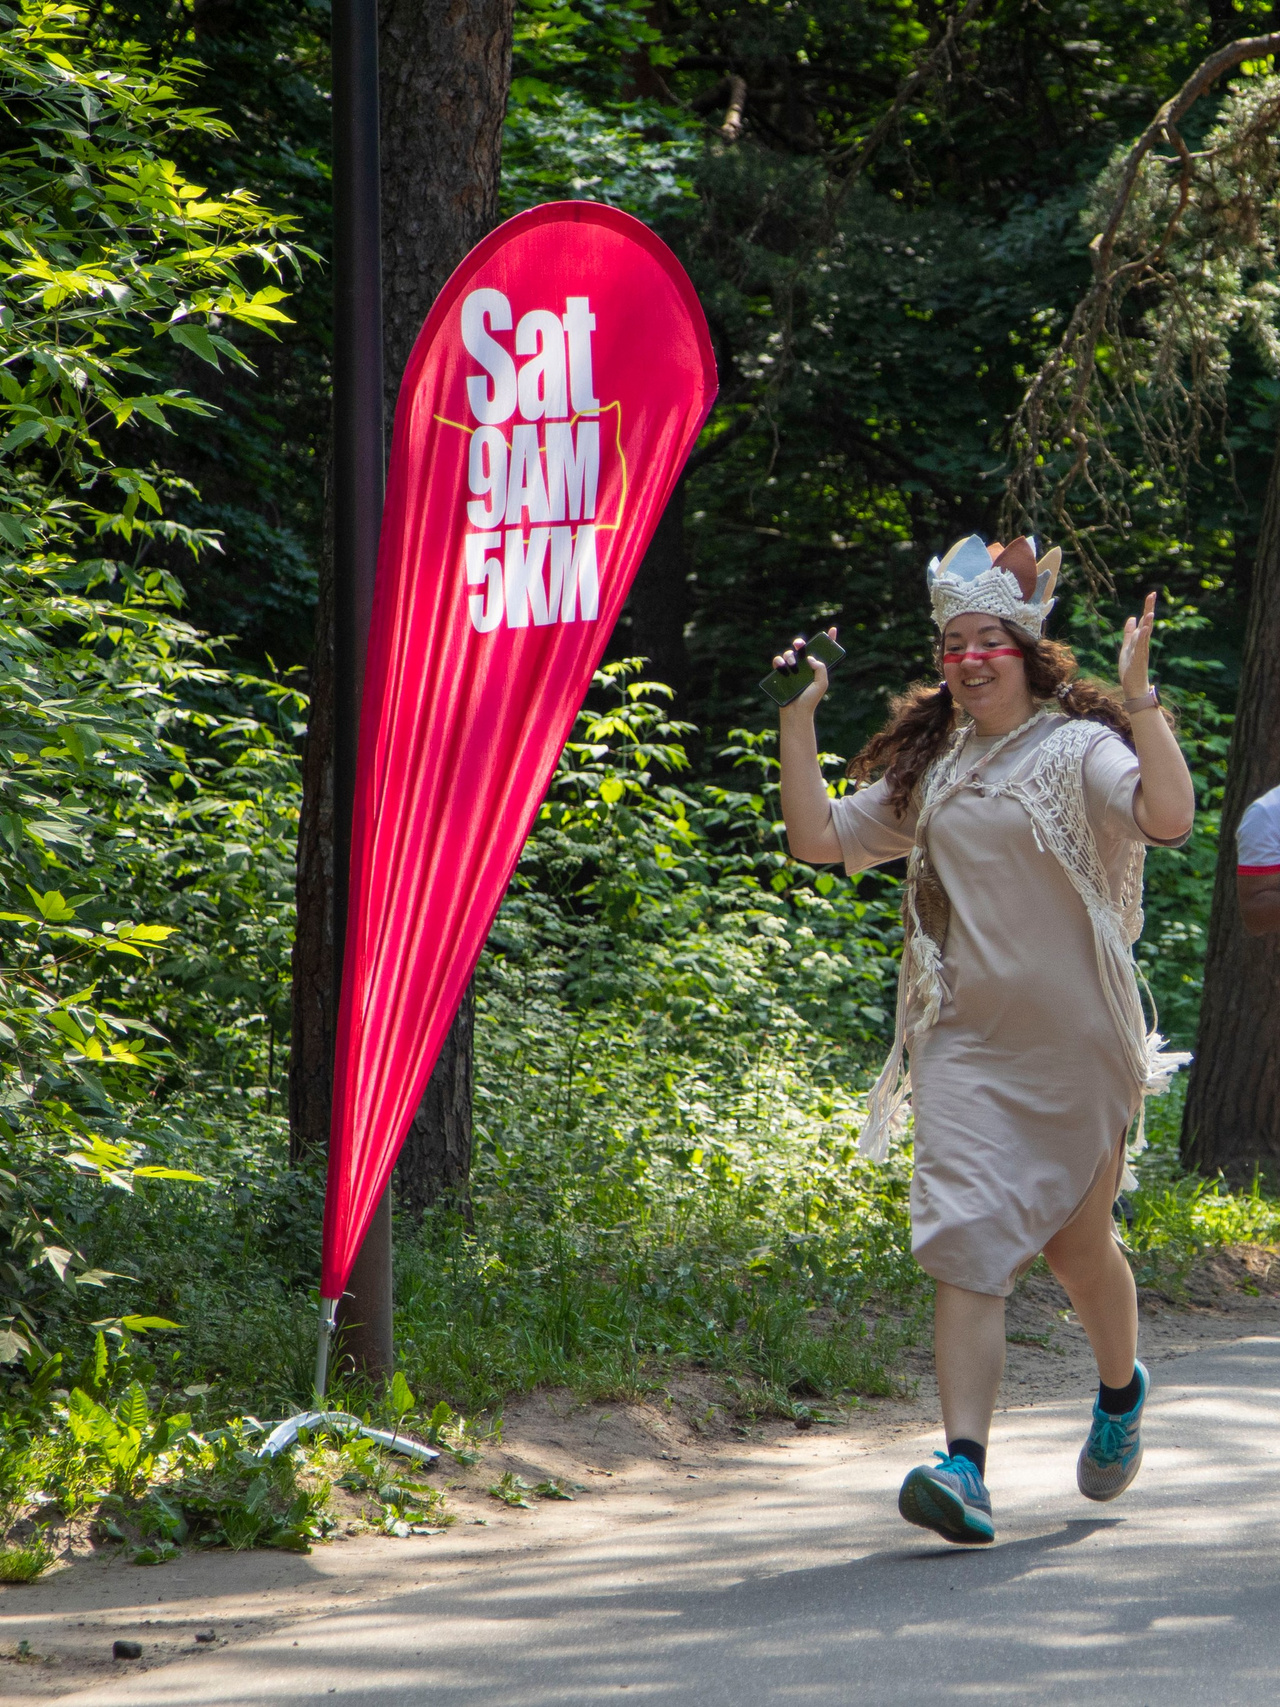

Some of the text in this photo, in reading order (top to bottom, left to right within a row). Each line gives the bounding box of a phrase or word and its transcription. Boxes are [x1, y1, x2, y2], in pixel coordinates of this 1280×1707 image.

[461, 288, 600, 425] Sat
[467, 421, 599, 529] 9AM
[465, 525, 599, 633] 5KM
